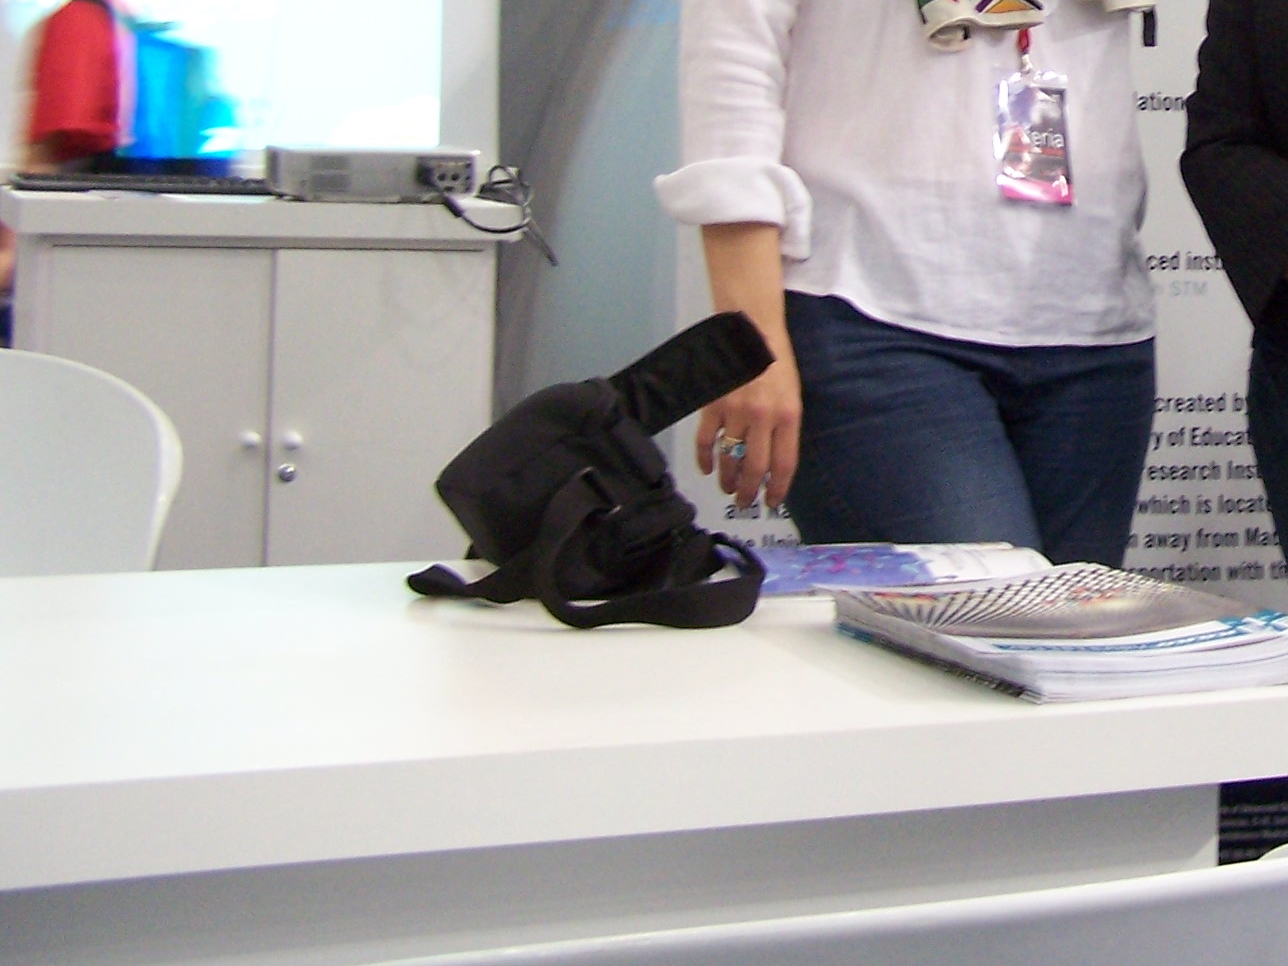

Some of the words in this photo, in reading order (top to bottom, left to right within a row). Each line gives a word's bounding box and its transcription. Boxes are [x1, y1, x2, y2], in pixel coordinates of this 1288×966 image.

[1154, 392, 1226, 412] created
[1136, 495, 1190, 514] which
[1196, 495, 1212, 514] is
[1144, 533, 1190, 553] away
[1196, 528, 1239, 548] from
[1227, 561, 1264, 580] with
